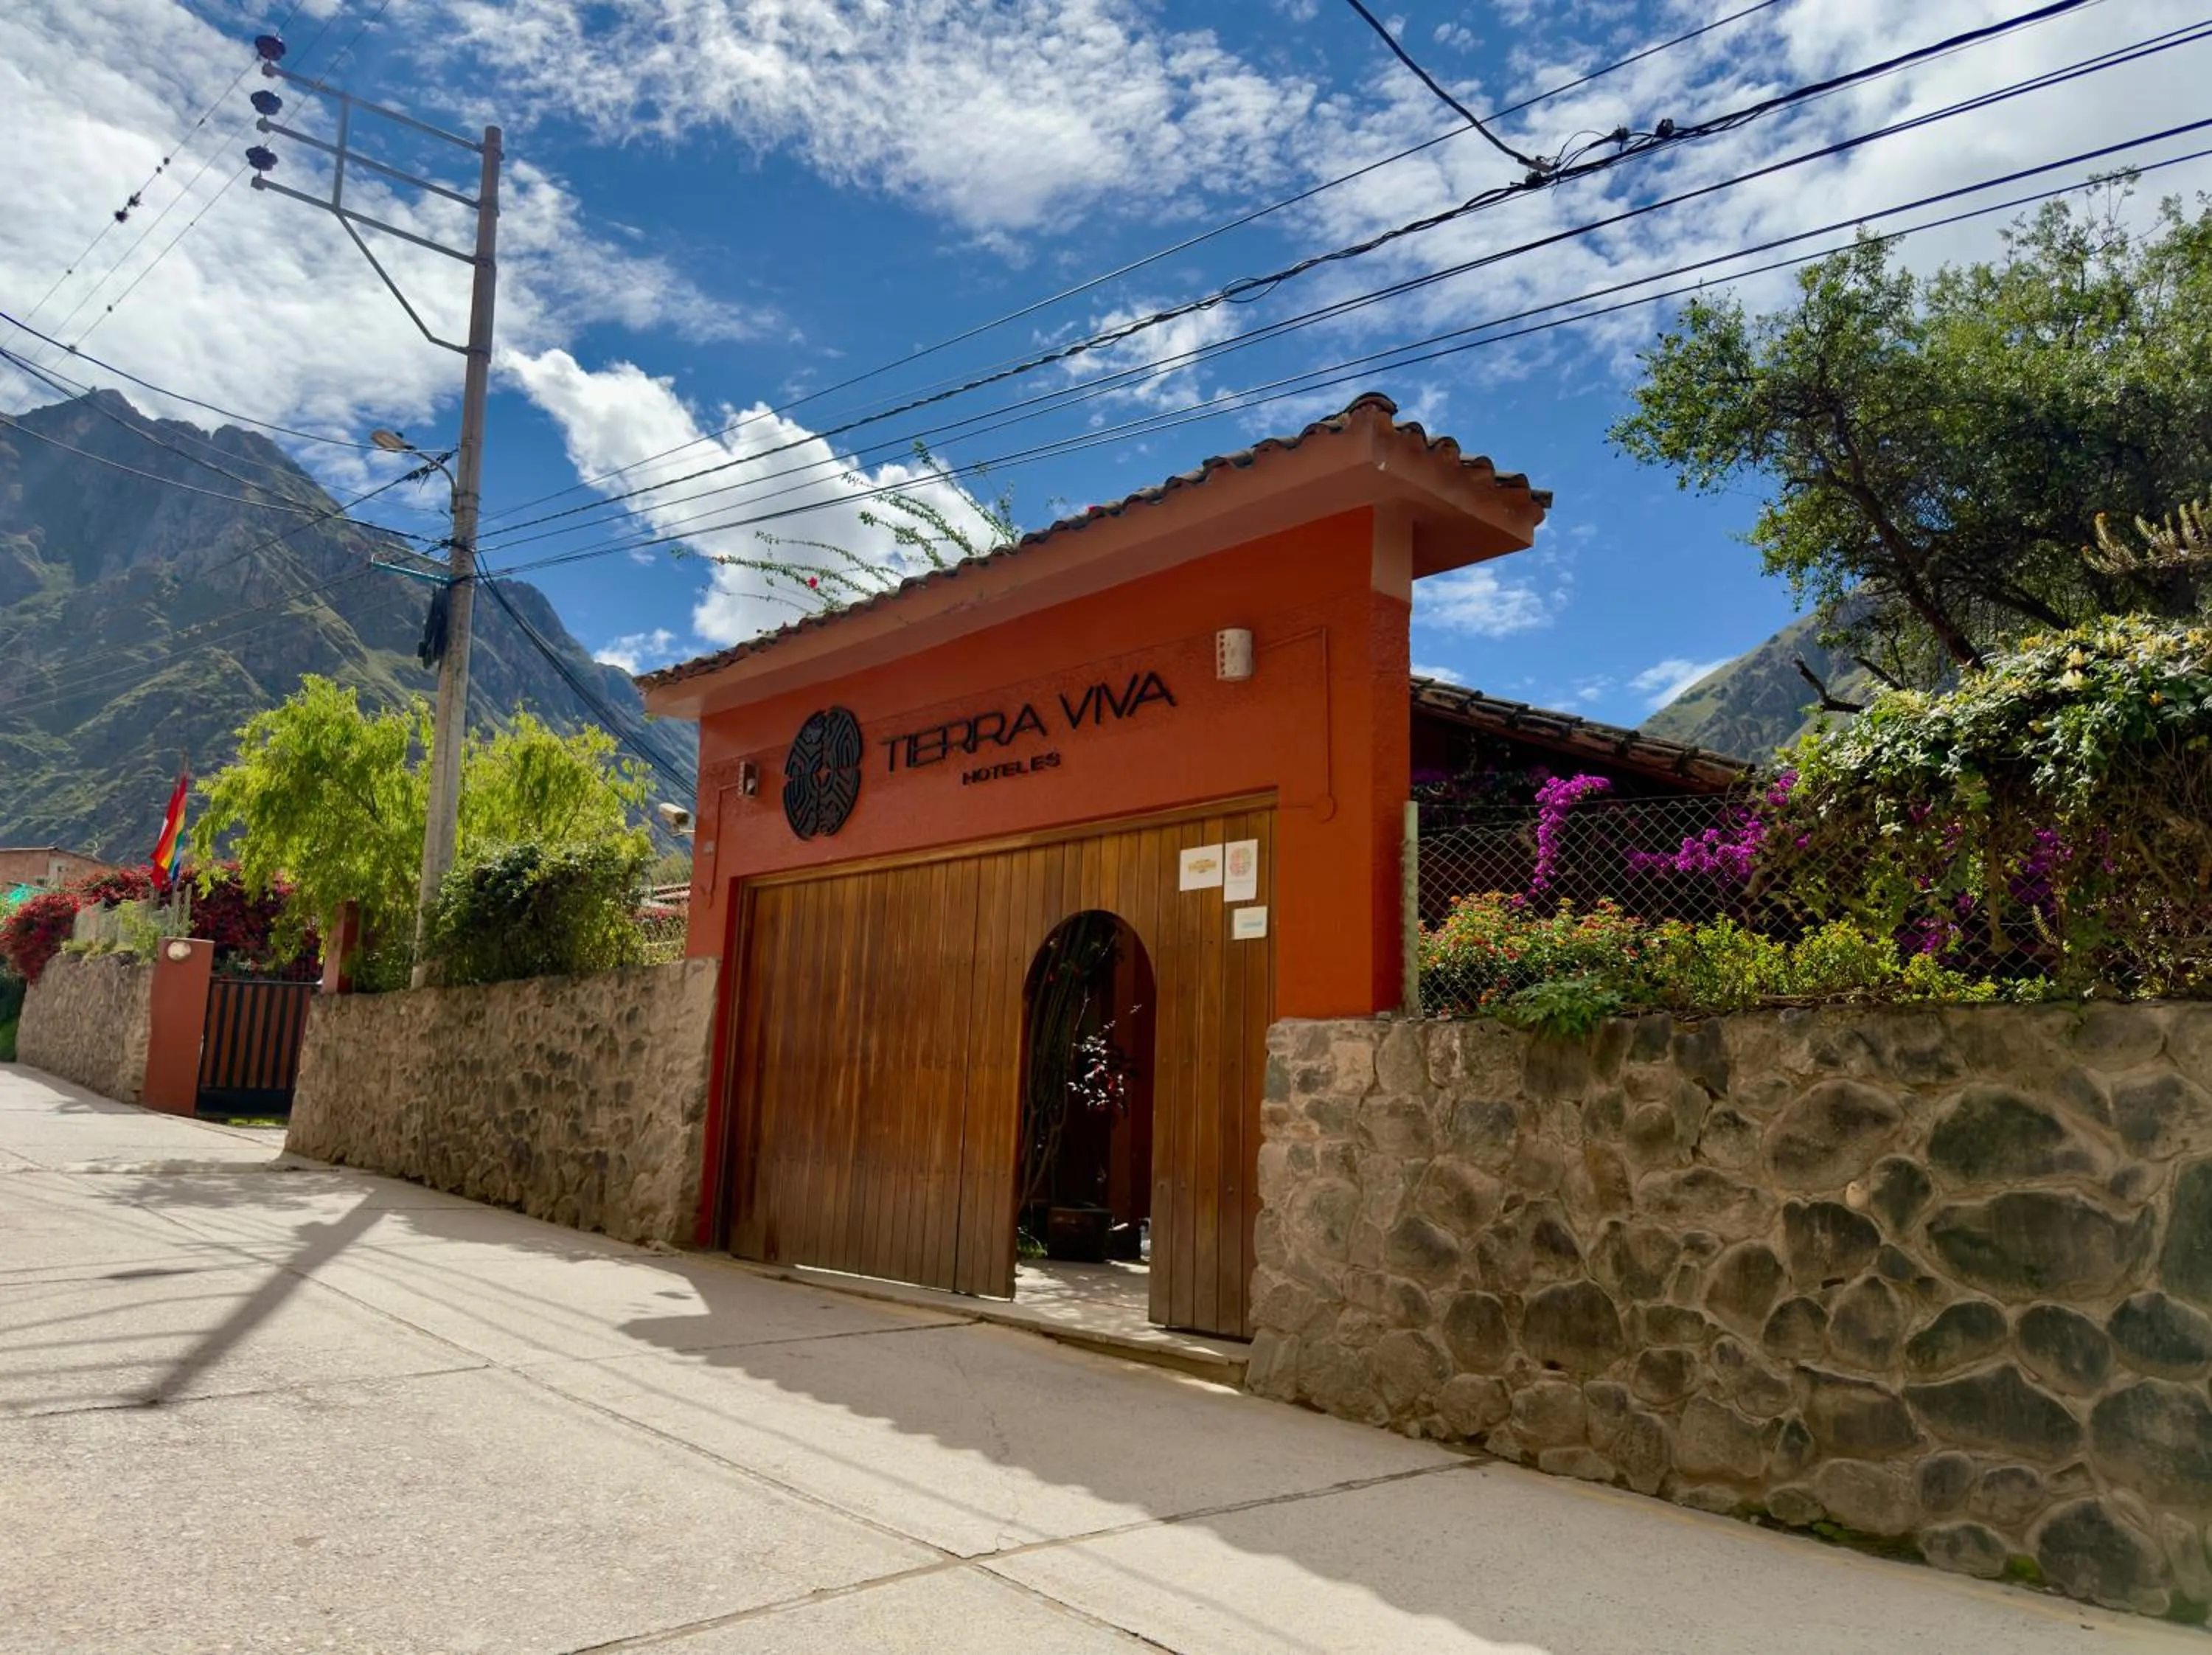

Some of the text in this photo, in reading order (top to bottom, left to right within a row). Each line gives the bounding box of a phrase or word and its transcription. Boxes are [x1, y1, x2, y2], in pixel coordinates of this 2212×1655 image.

[880, 672, 1177, 772] TIERRA VIVA
[963, 752, 1060, 785] HOTELES
